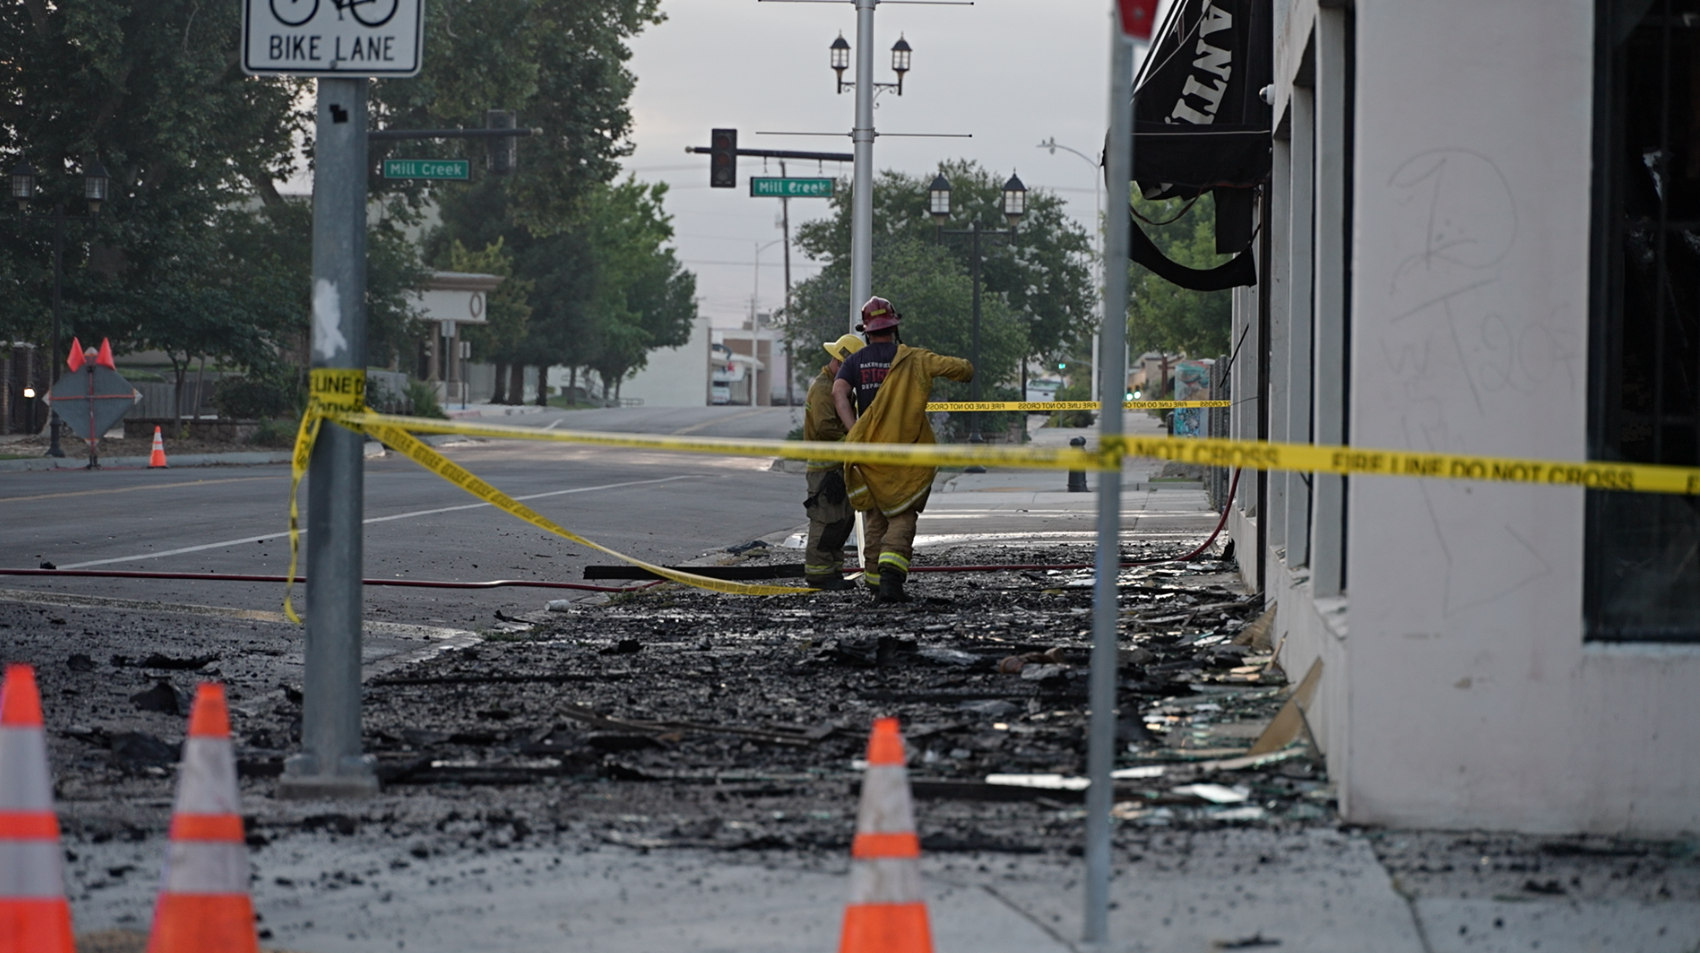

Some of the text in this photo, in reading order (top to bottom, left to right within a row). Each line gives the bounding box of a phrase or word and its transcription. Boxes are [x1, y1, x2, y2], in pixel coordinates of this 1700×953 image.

[269, 35, 396, 62] BIKE LANE
[1165, 0, 1232, 125] ANTI
[390, 163, 463, 176] Mill Creek
[759, 181, 827, 194] Mill Creek
[315, 376, 352, 394] LINE
[1191, 442, 1279, 466] CROSS
[1331, 452, 1383, 470] FIRE
[1450, 459, 1487, 479] DO
[1493, 463, 1542, 482] NOT
[1548, 465, 1635, 490] CROSS
